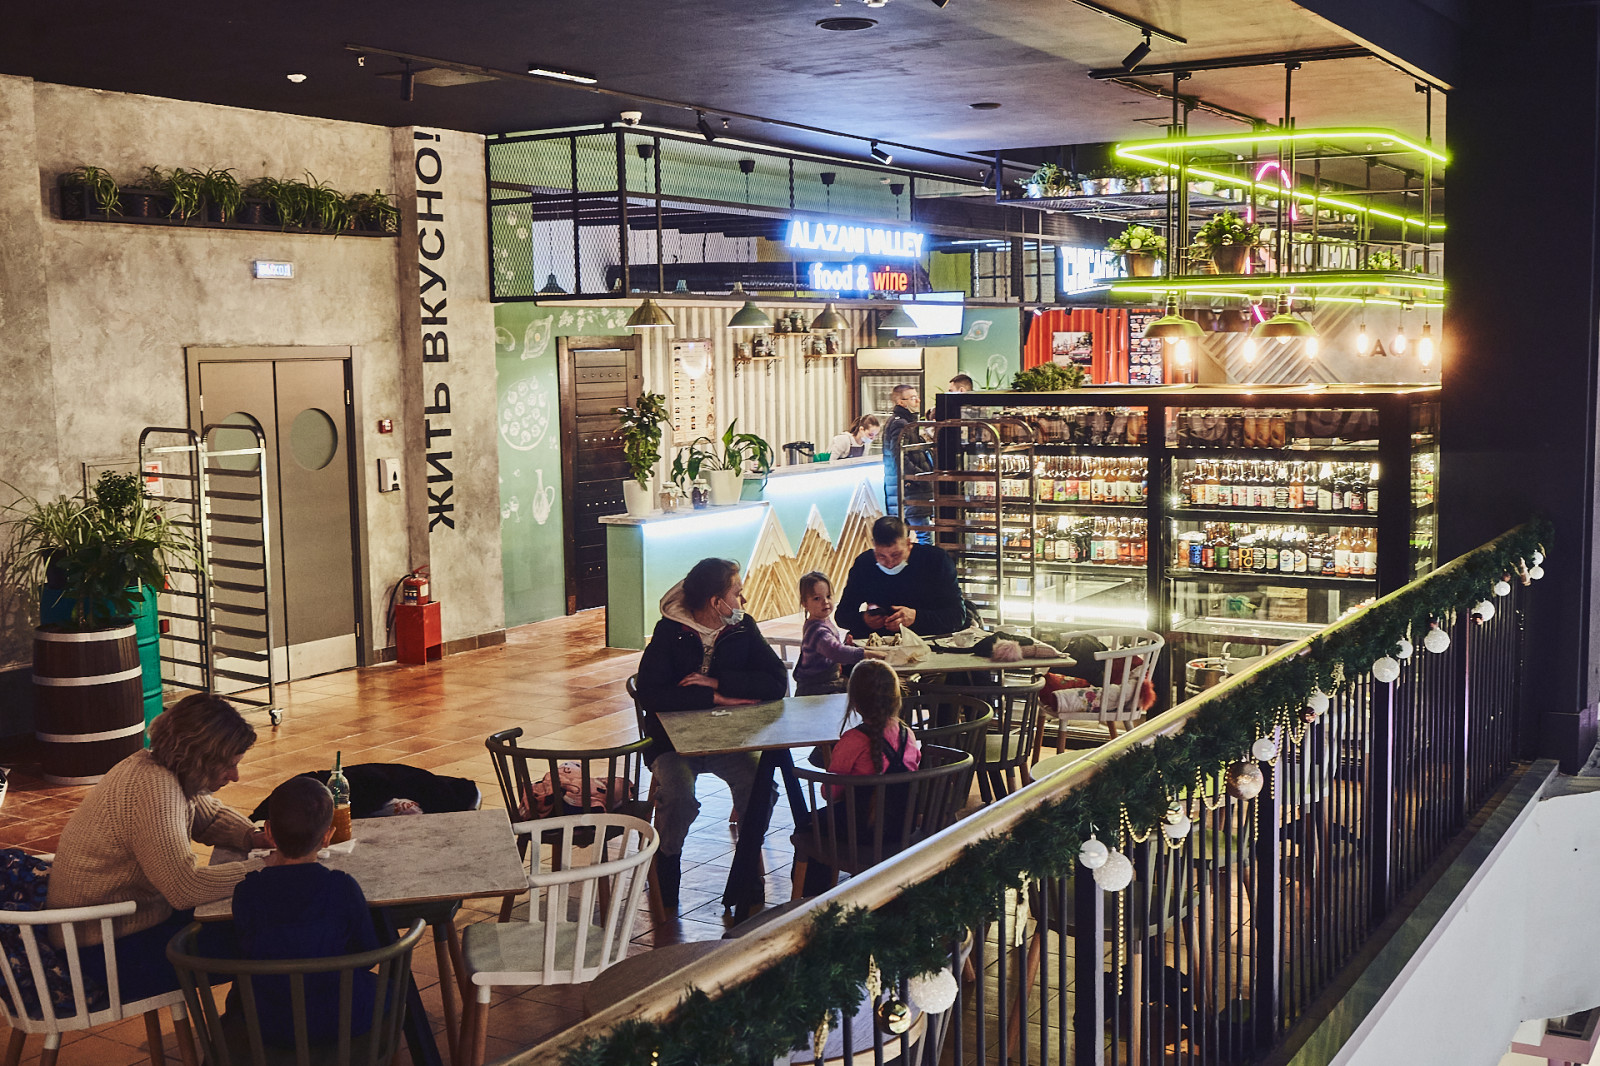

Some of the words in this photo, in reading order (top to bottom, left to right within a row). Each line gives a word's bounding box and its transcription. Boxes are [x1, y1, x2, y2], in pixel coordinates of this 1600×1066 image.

[413, 131, 449, 363] ВКУСНО!
[790, 220, 865, 253] ALAZANI
[865, 227, 924, 257] VALLEY
[813, 262, 852, 290] food
[857, 264, 869, 291] &
[873, 265, 908, 291] wine
[423, 382, 455, 533] ЖИТЬ
